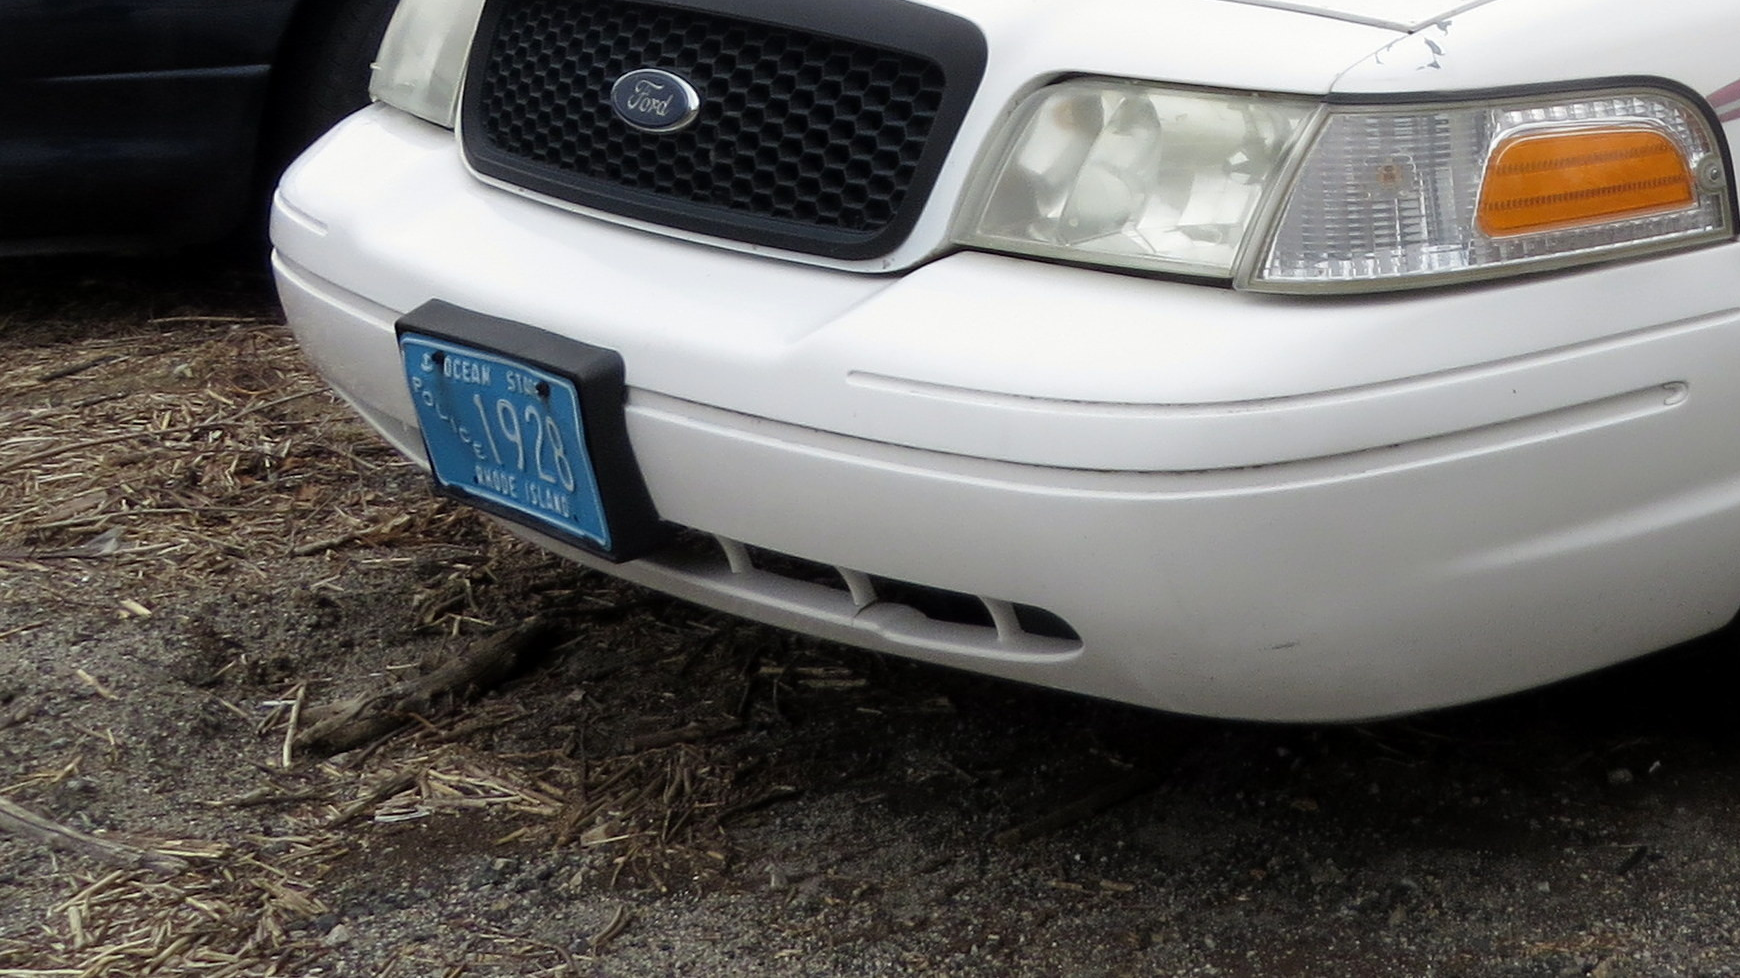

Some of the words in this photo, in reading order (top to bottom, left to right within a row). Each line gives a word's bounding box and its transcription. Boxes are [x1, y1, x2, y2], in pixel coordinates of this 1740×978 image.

[627, 79, 675, 117] Ford
[443, 355, 491, 386] OCEAN
[472, 393, 575, 492] 1928
[475, 464, 518, 498] RHODE
[525, 482, 570, 519] ISLAND
